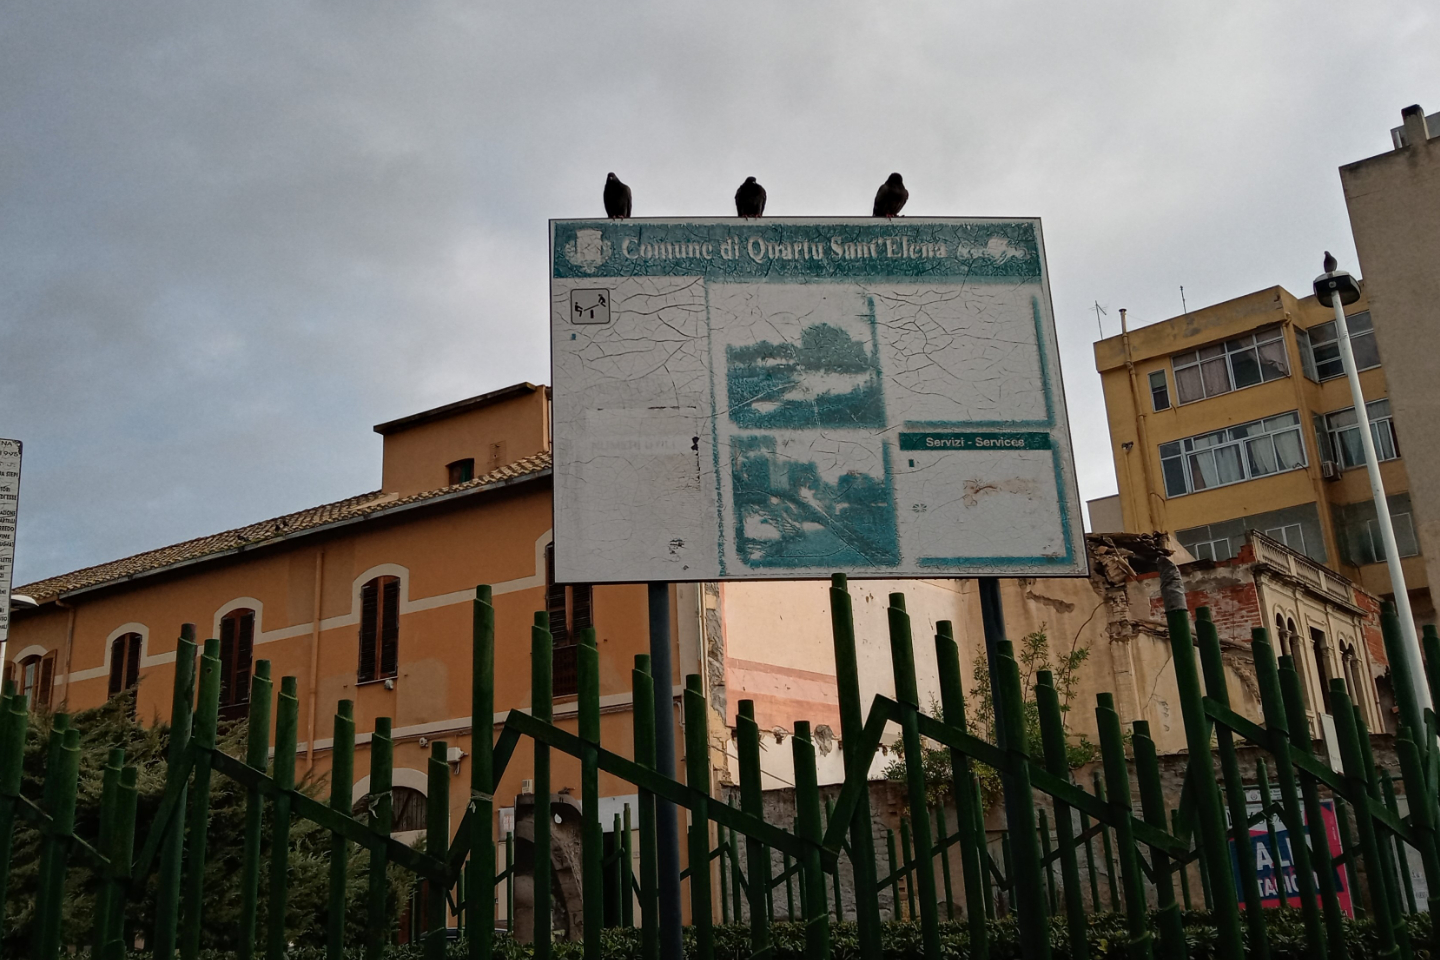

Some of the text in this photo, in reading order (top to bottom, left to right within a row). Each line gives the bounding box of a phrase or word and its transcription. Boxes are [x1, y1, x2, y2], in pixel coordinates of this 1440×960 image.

[622, 235, 947, 263] Comune di Quartu Sant'Elena
[926, 436, 965, 447] Servizi
[975, 437, 1025, 448] Services
